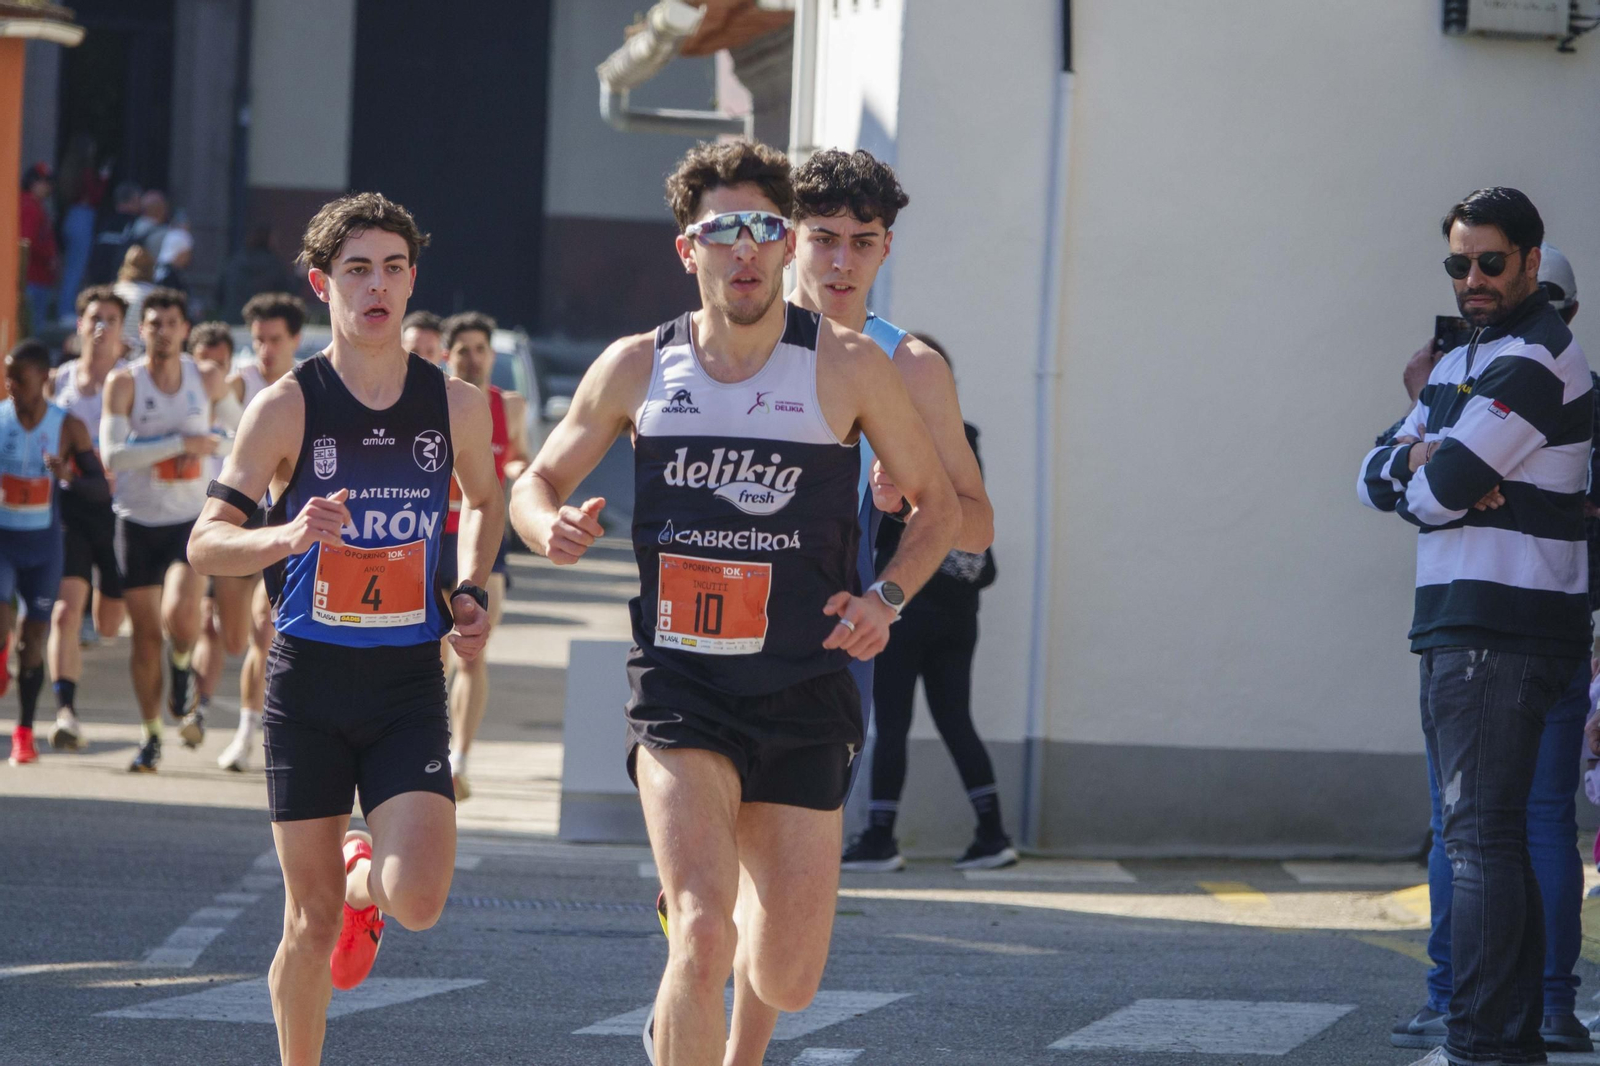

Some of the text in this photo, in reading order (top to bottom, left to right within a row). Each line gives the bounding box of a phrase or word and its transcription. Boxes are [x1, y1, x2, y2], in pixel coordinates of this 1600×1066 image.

[774, 405, 804, 413] DELIKIA
[362, 437, 396, 446] amura
[663, 447, 803, 493] delikia
[359, 487, 431, 499] ATLETISMO
[738, 490, 775, 504] fresh
[340, 501, 439, 541] ARÓN
[363, 565, 386, 574] ANXO
[361, 574, 382, 611] 4
[694, 592, 723, 635] 10
